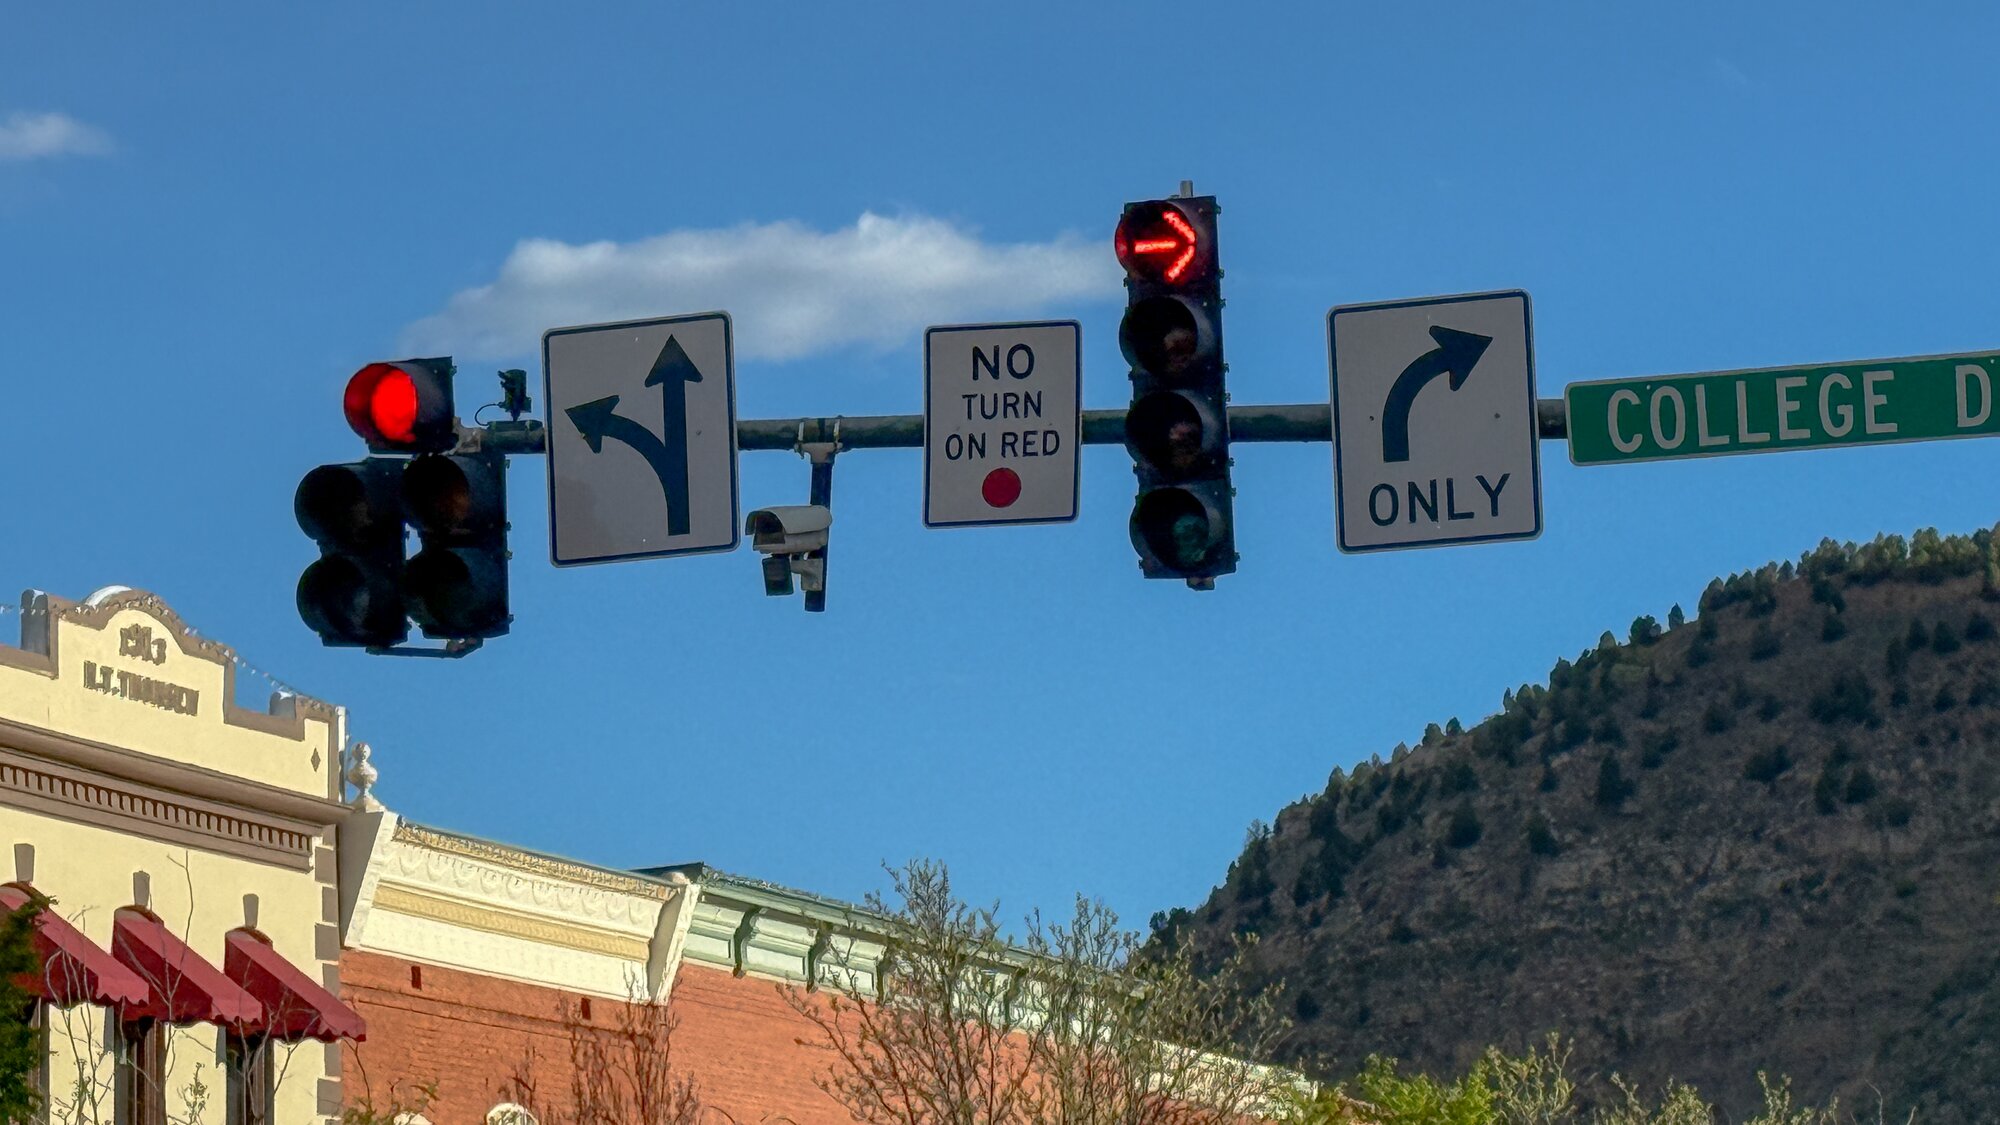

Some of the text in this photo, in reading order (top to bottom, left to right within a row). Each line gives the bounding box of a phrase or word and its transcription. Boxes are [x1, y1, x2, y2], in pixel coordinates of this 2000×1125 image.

[972, 343, 1035, 381] NO
[962, 390, 1042, 420] TURN
[1607, 370, 1898, 454] COLLEGE
[945, 430, 1060, 461] ON RED
[1368, 473, 1511, 527] ONLY
